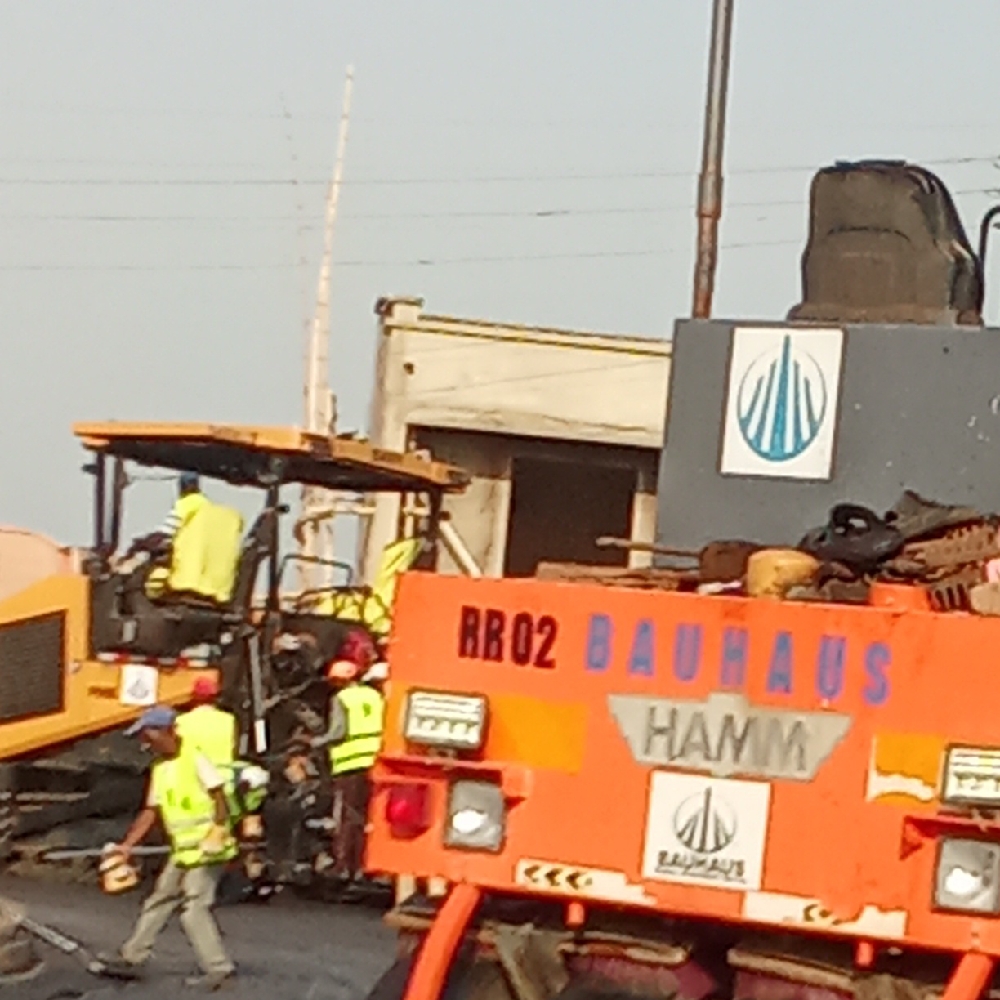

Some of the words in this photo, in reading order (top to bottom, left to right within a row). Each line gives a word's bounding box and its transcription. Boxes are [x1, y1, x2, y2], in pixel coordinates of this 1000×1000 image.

[458, 604, 558, 670] RR02
[586, 614, 891, 703] BAUHAUS
[643, 705, 806, 772] HAMM
